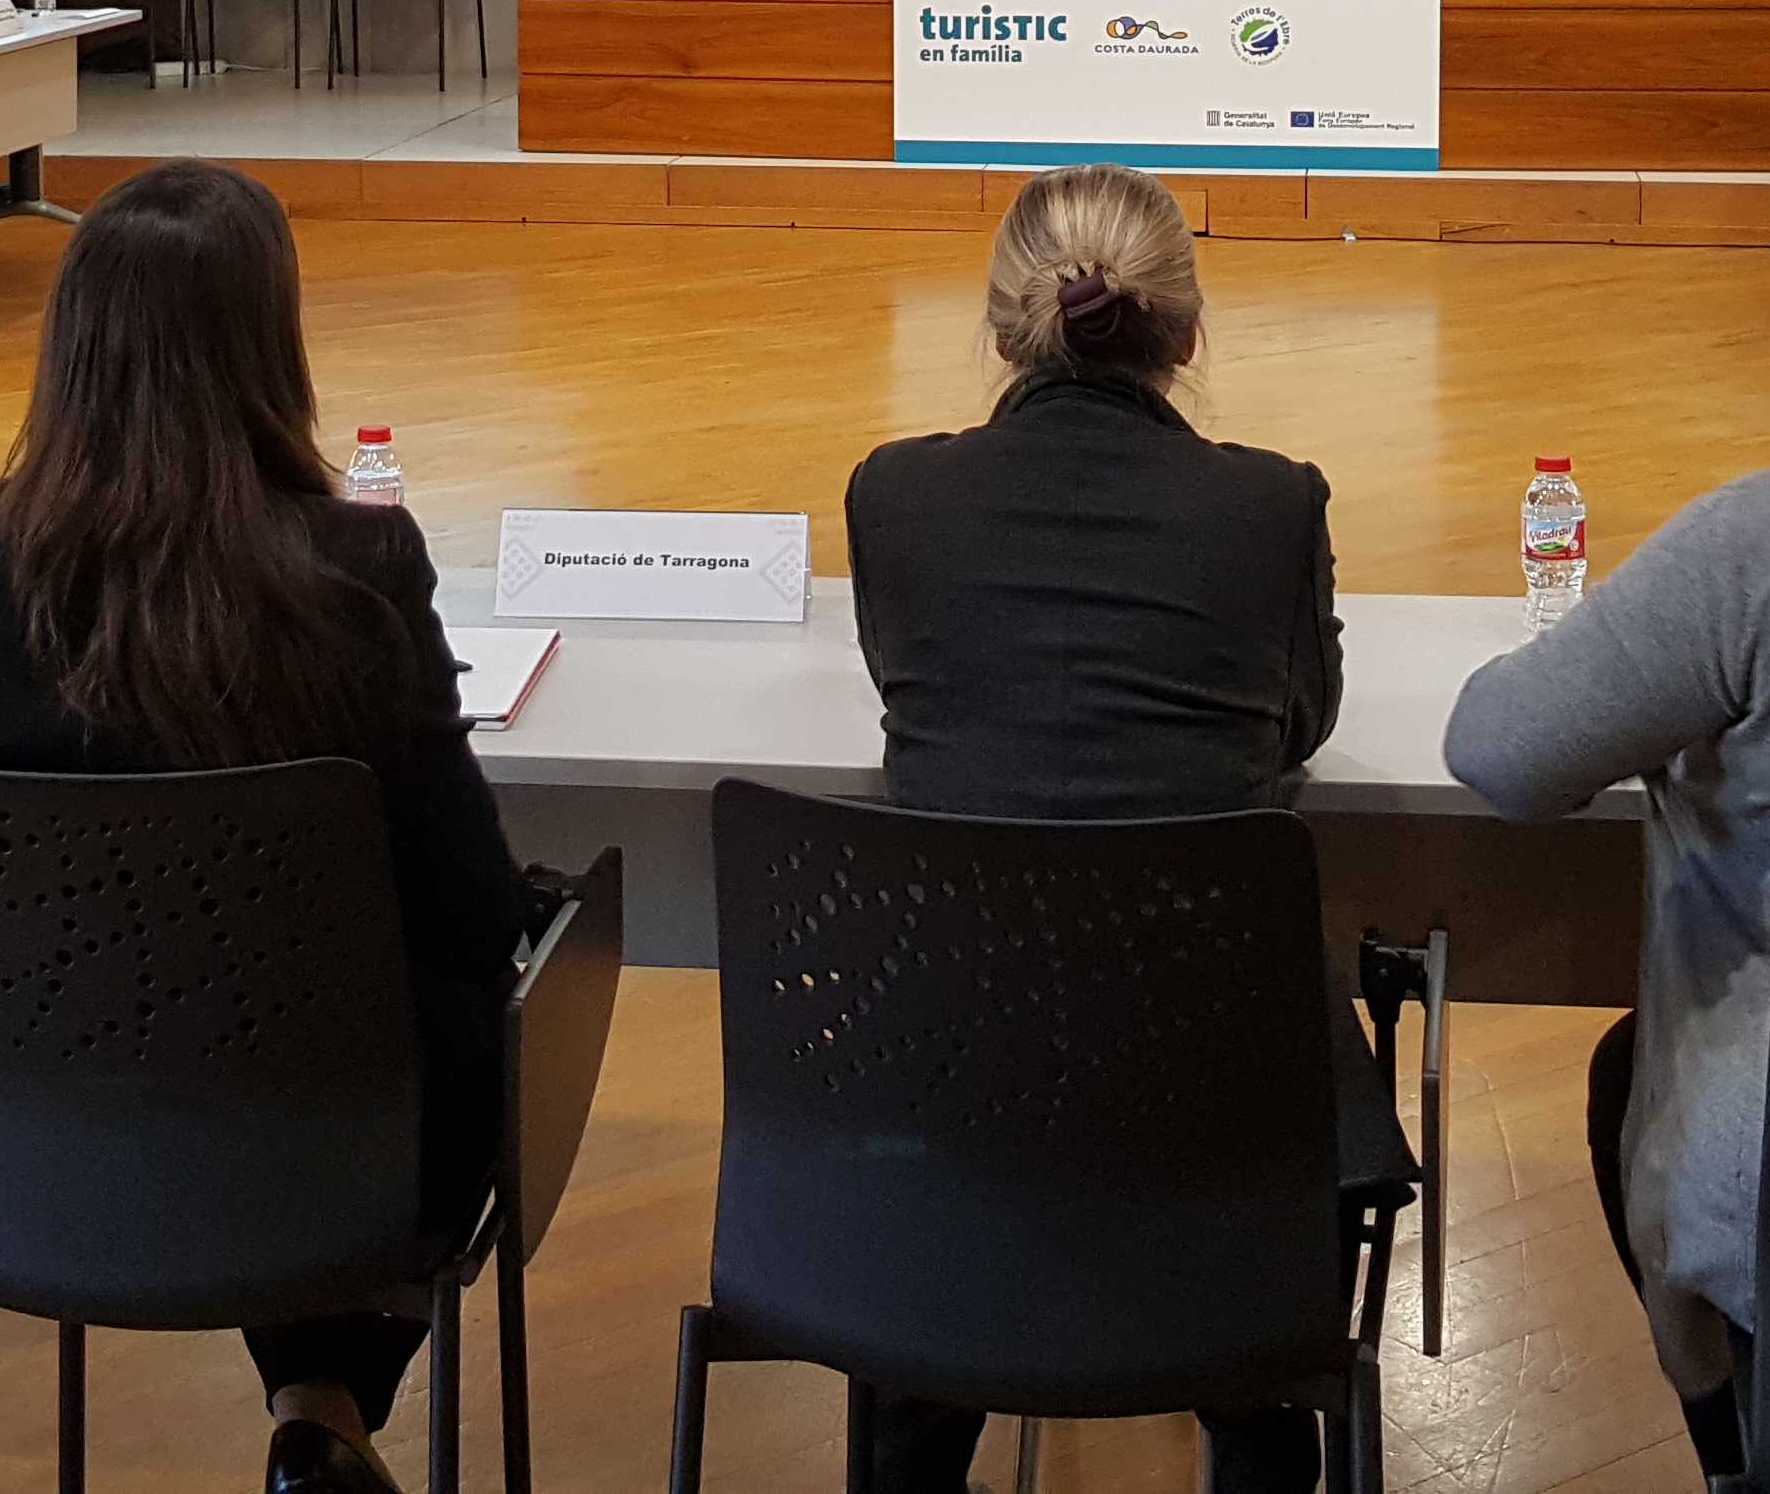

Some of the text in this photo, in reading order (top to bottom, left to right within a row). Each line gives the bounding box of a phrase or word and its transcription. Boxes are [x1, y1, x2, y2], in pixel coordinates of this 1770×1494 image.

[920, 44, 1022, 62] en família
[1095, 44, 1200, 54] COSTA DAURADA
[544, 551, 750, 571] Diputació de Tarragona
